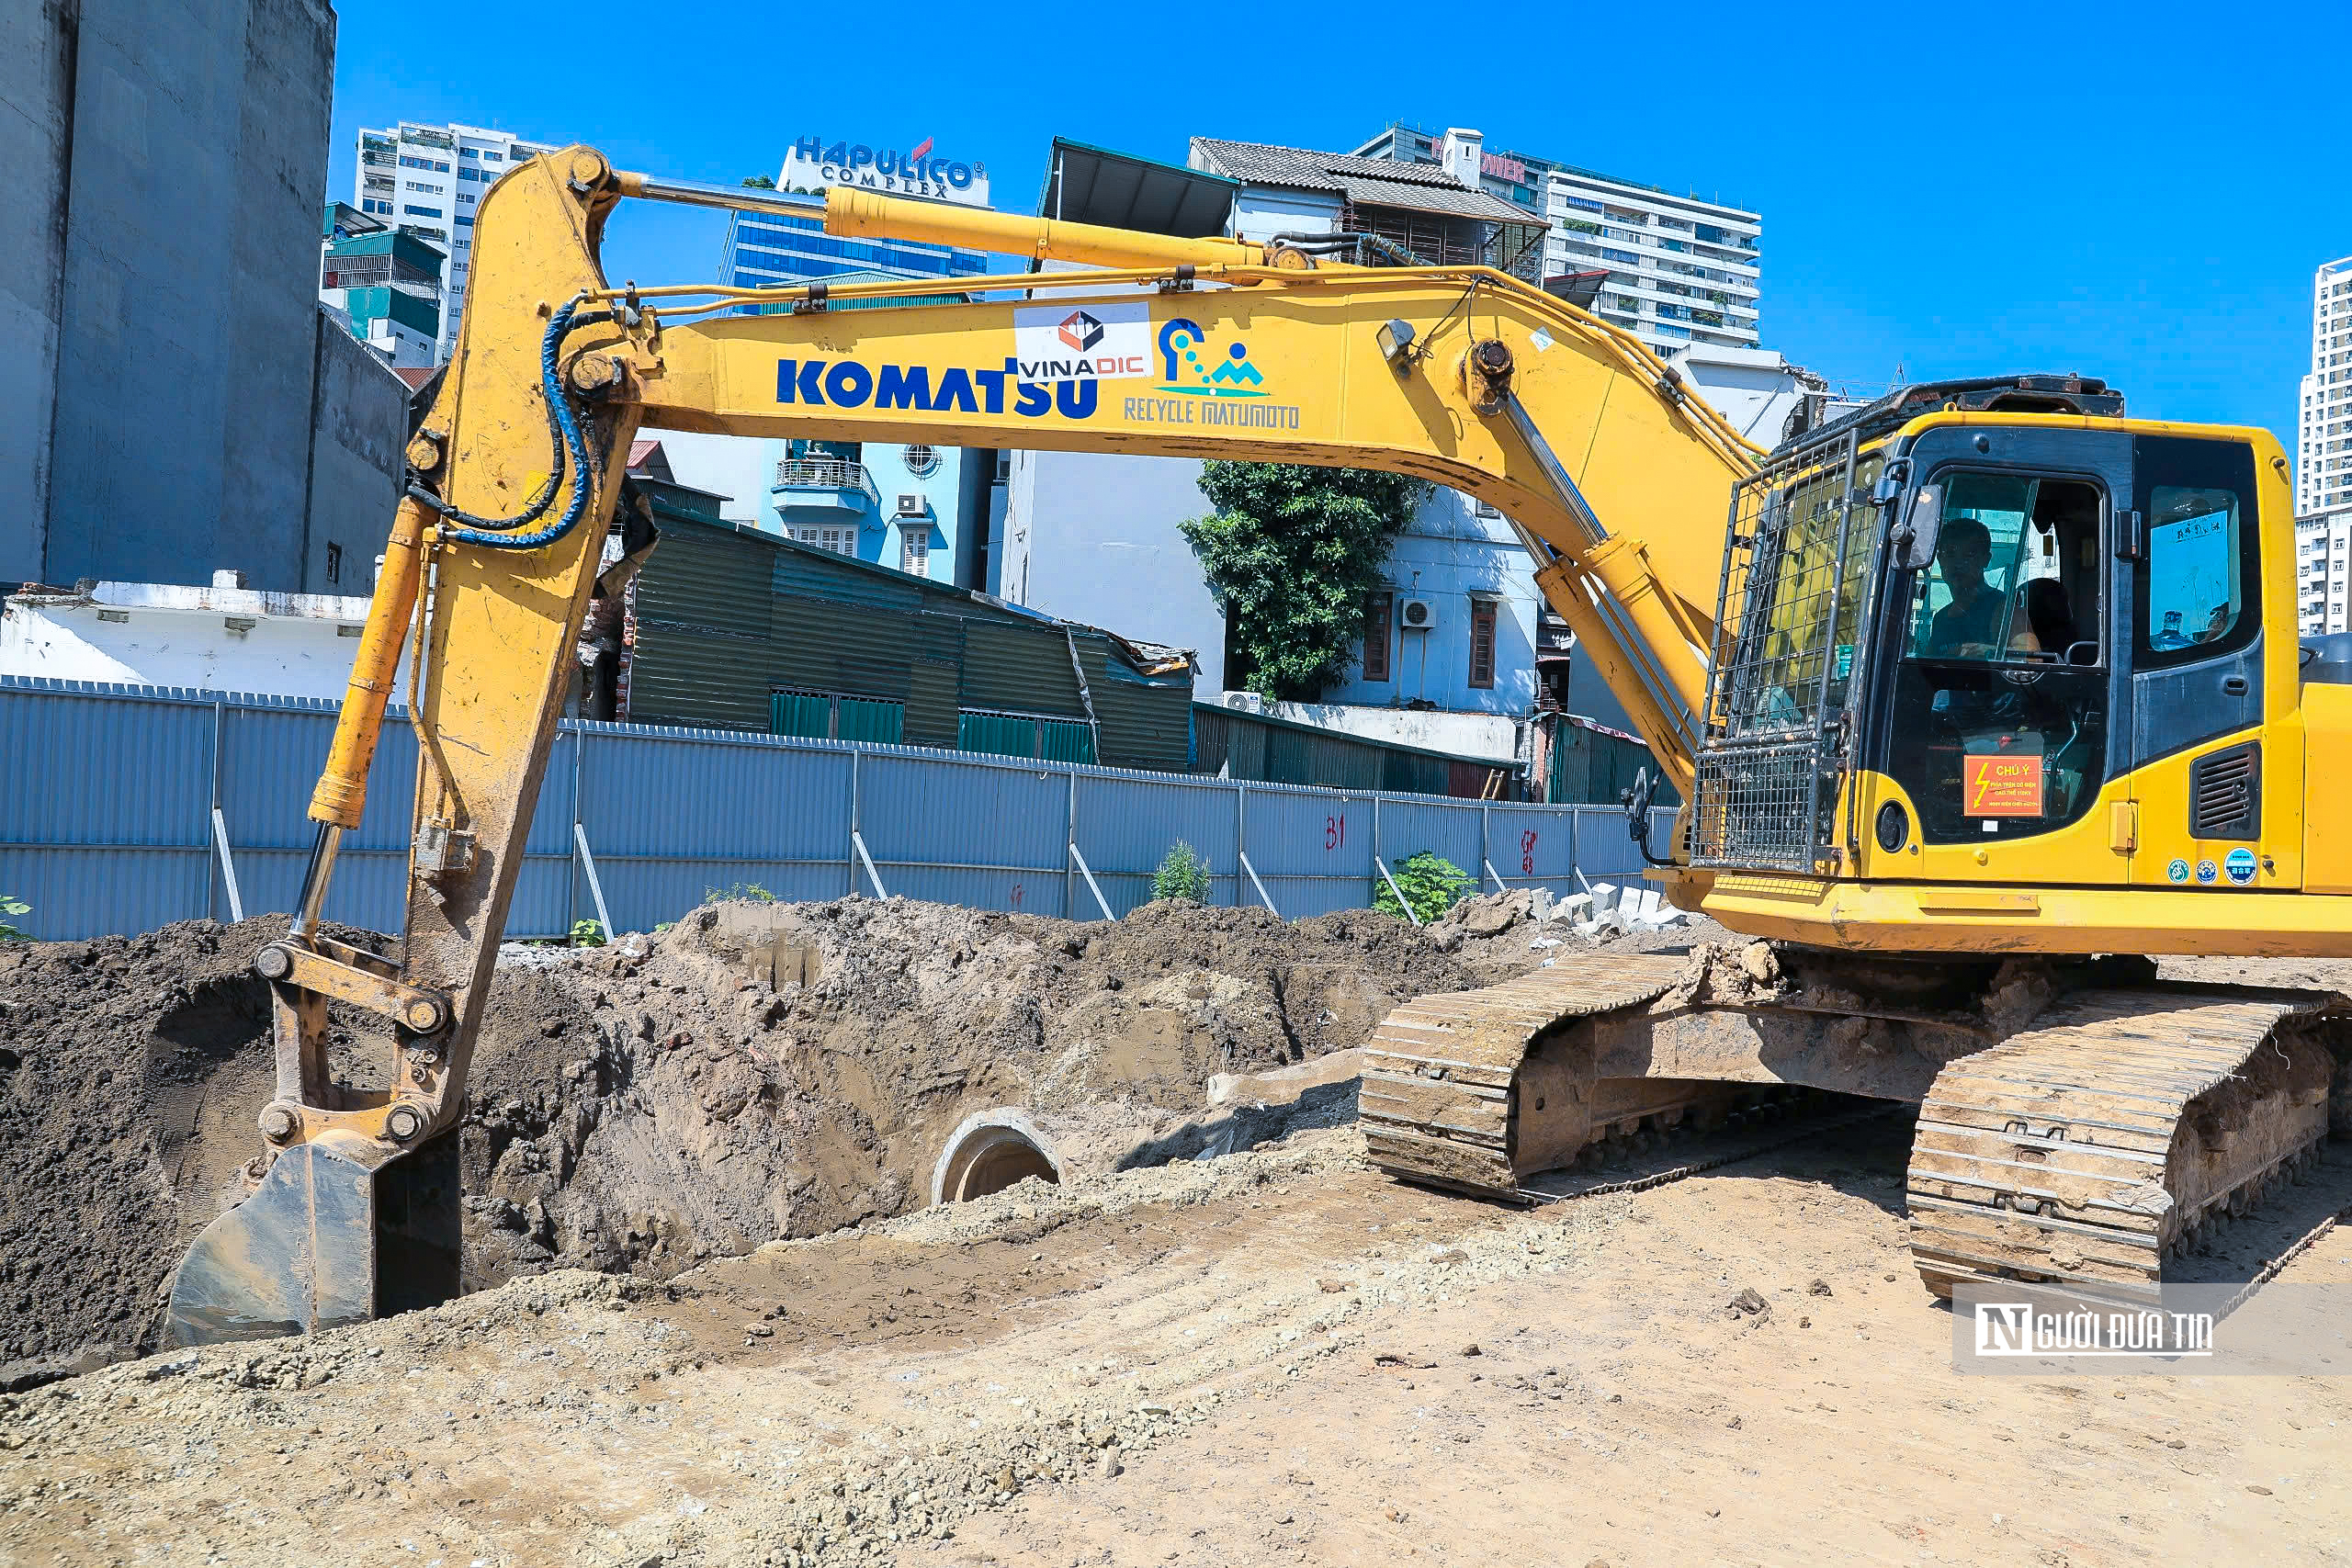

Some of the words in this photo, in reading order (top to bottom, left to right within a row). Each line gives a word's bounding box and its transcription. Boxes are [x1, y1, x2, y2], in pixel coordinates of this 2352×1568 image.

[821, 165, 947, 198] COMPLEX
[1480, 152, 1525, 184] OWER
[1019, 356, 1144, 378] VINADIC
[776, 357, 1098, 419] KOMATSU
[1125, 397, 1193, 423] RECYCLE
[1202, 404, 1300, 429] MATUMOTO
[1996, 764, 2019, 776] CHÚ
[2022, 764, 2029, 775] Ý
[1325, 814, 1345, 851] 31
